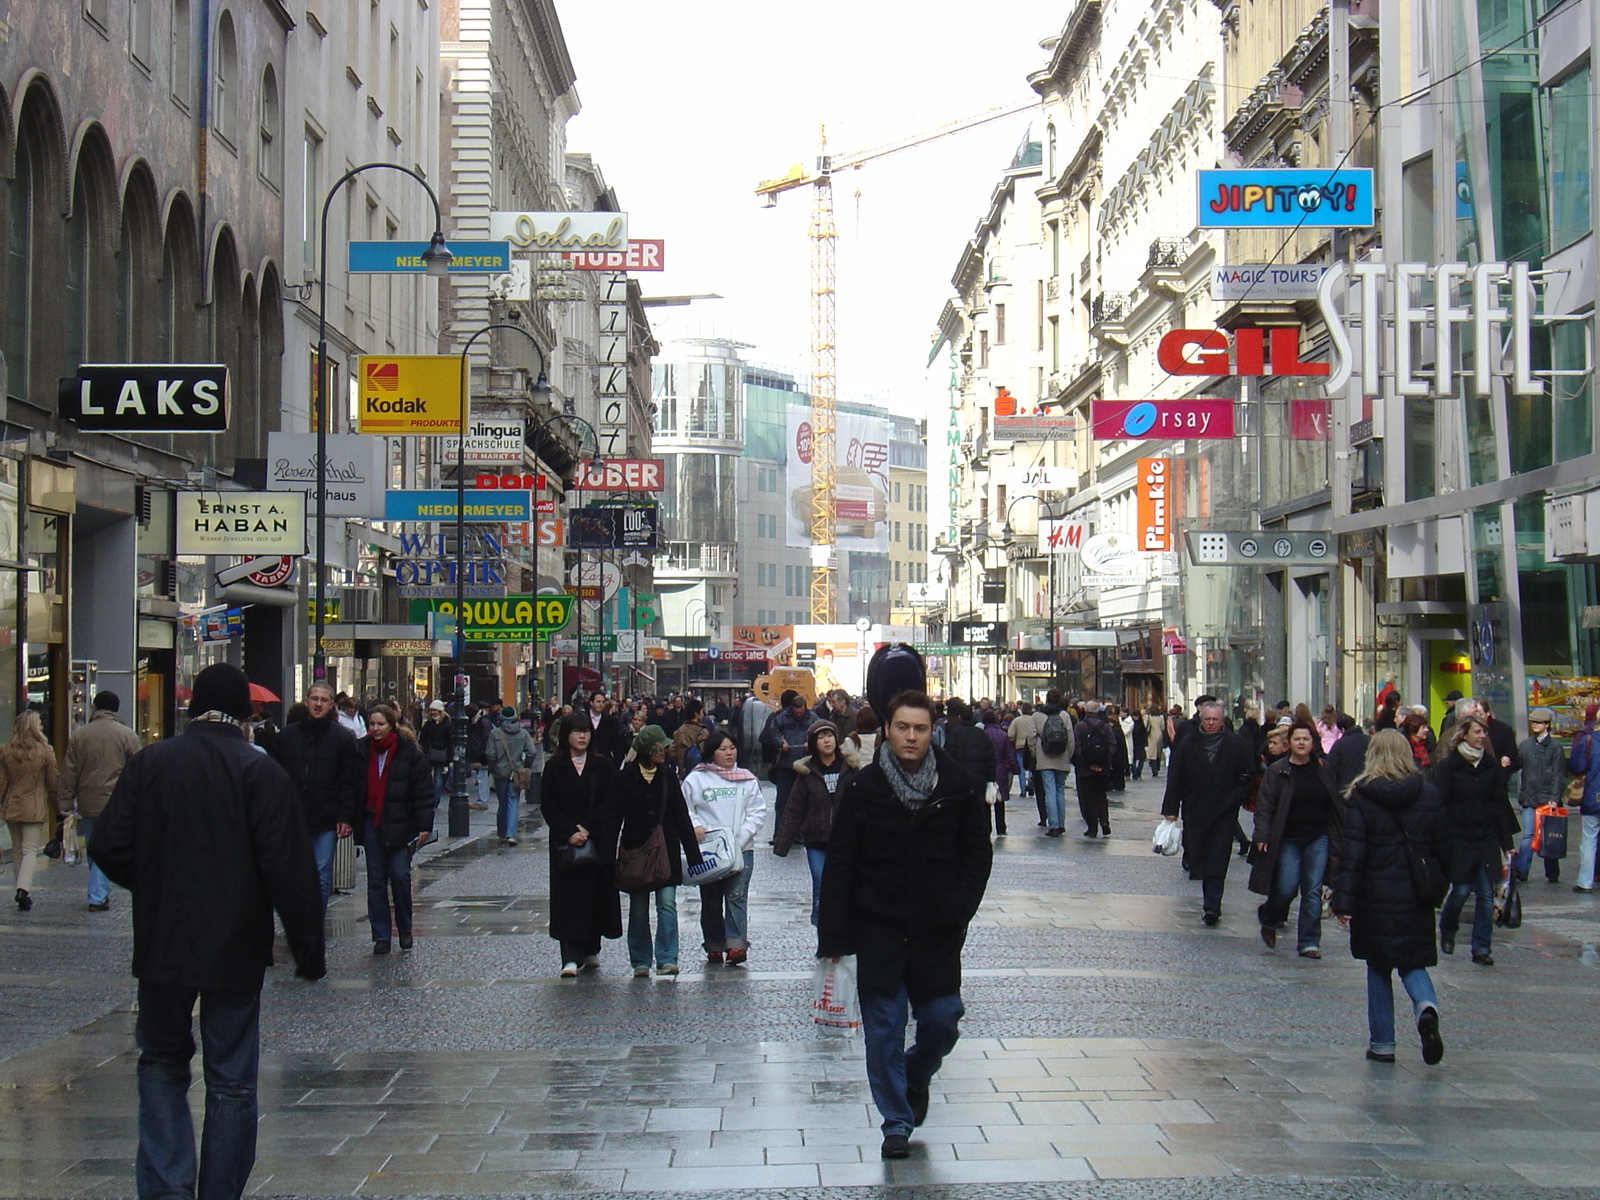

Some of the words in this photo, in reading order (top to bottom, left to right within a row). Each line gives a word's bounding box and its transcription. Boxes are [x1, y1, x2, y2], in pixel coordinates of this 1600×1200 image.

[396, 256, 502, 267] NiEMEYER
[1216, 270, 1265, 283] MAGIC
[1271, 269, 1318, 284] TOURS
[1316, 258, 1545, 397] STEFFL
[1157, 327, 1330, 377] GIL
[81, 379, 220, 415] LAKS
[367, 397, 427, 414] Kodak
[469, 422, 521, 440] nlingua
[446, 440, 520, 449] SPACHSCHULE
[947, 352, 961, 543] SALAMANDER
[200, 504, 261, 514] ERNST
[268, 504, 285, 514] A.
[1144, 460, 1166, 550] Pimkie
[195, 518, 288, 532] HABAN
[253, 564, 290, 586] TABAK
[439, 601, 566, 626] PAWLATA
